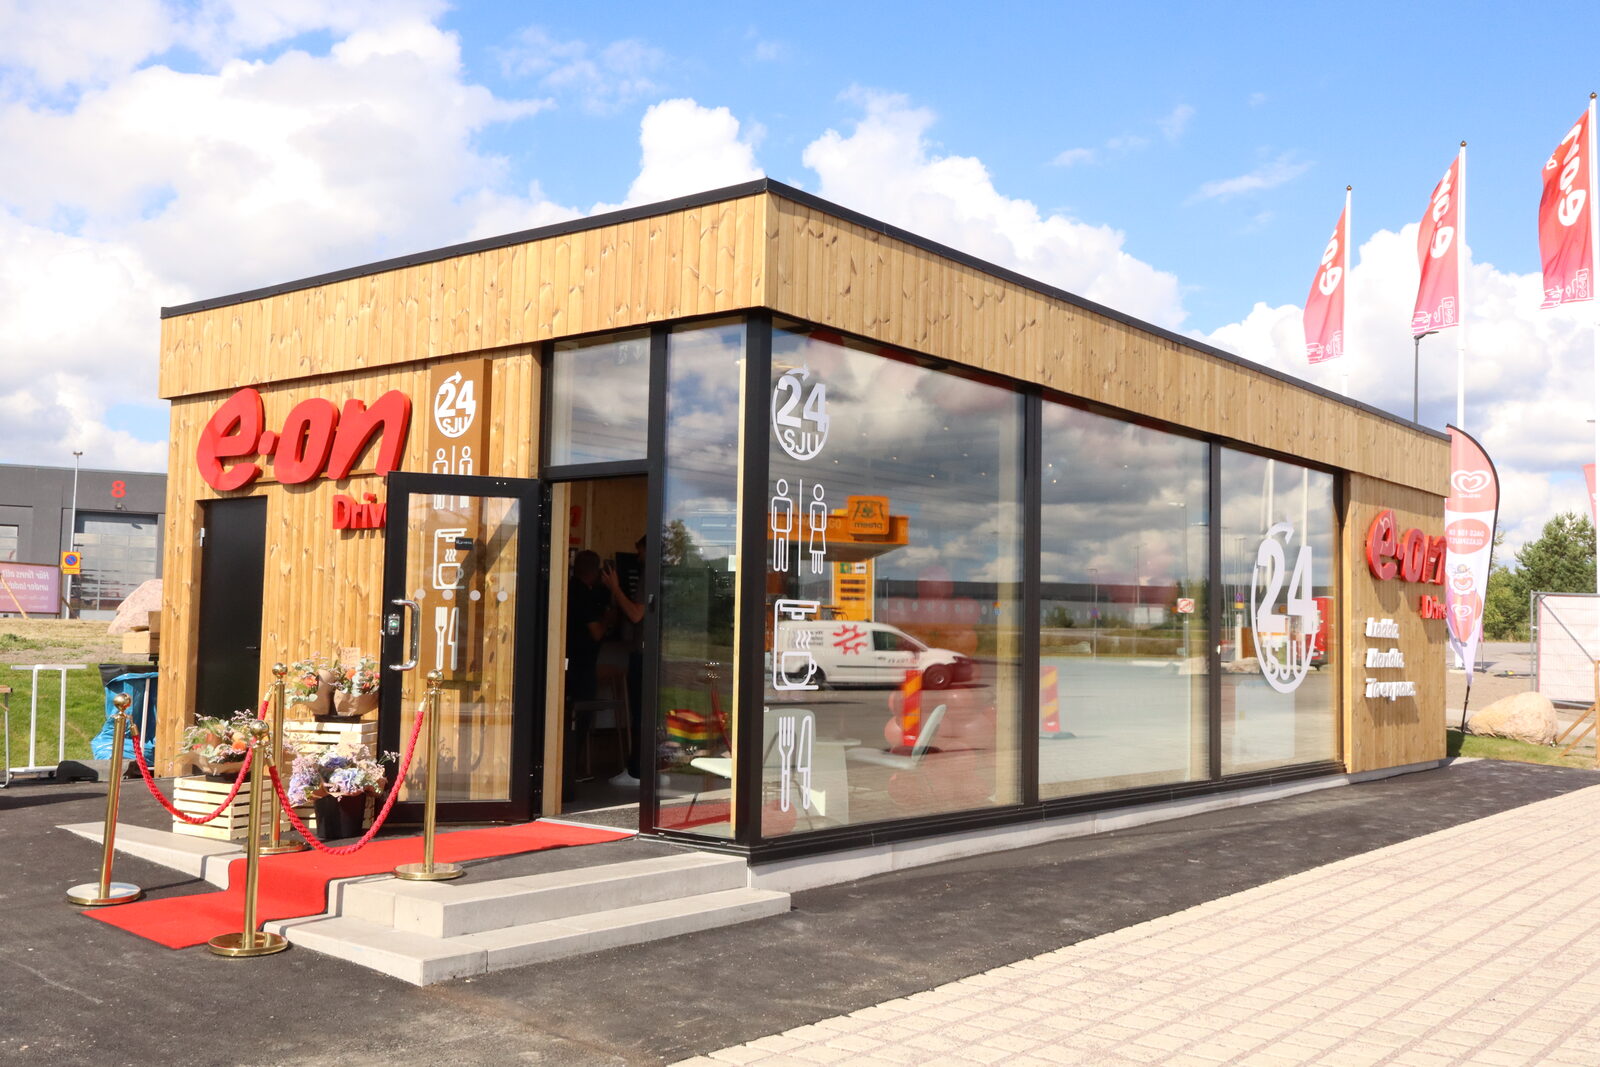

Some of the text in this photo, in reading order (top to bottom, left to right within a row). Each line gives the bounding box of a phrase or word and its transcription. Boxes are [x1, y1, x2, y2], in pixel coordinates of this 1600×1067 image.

[438, 380, 477, 418] 24
[777, 375, 830, 433] 24
[442, 416, 470, 433] SJU
[784, 429, 820, 454] SJU
[111, 480, 126, 498] 8
[332, 492, 387, 530] Driv
[1257, 538, 1318, 634] 24
